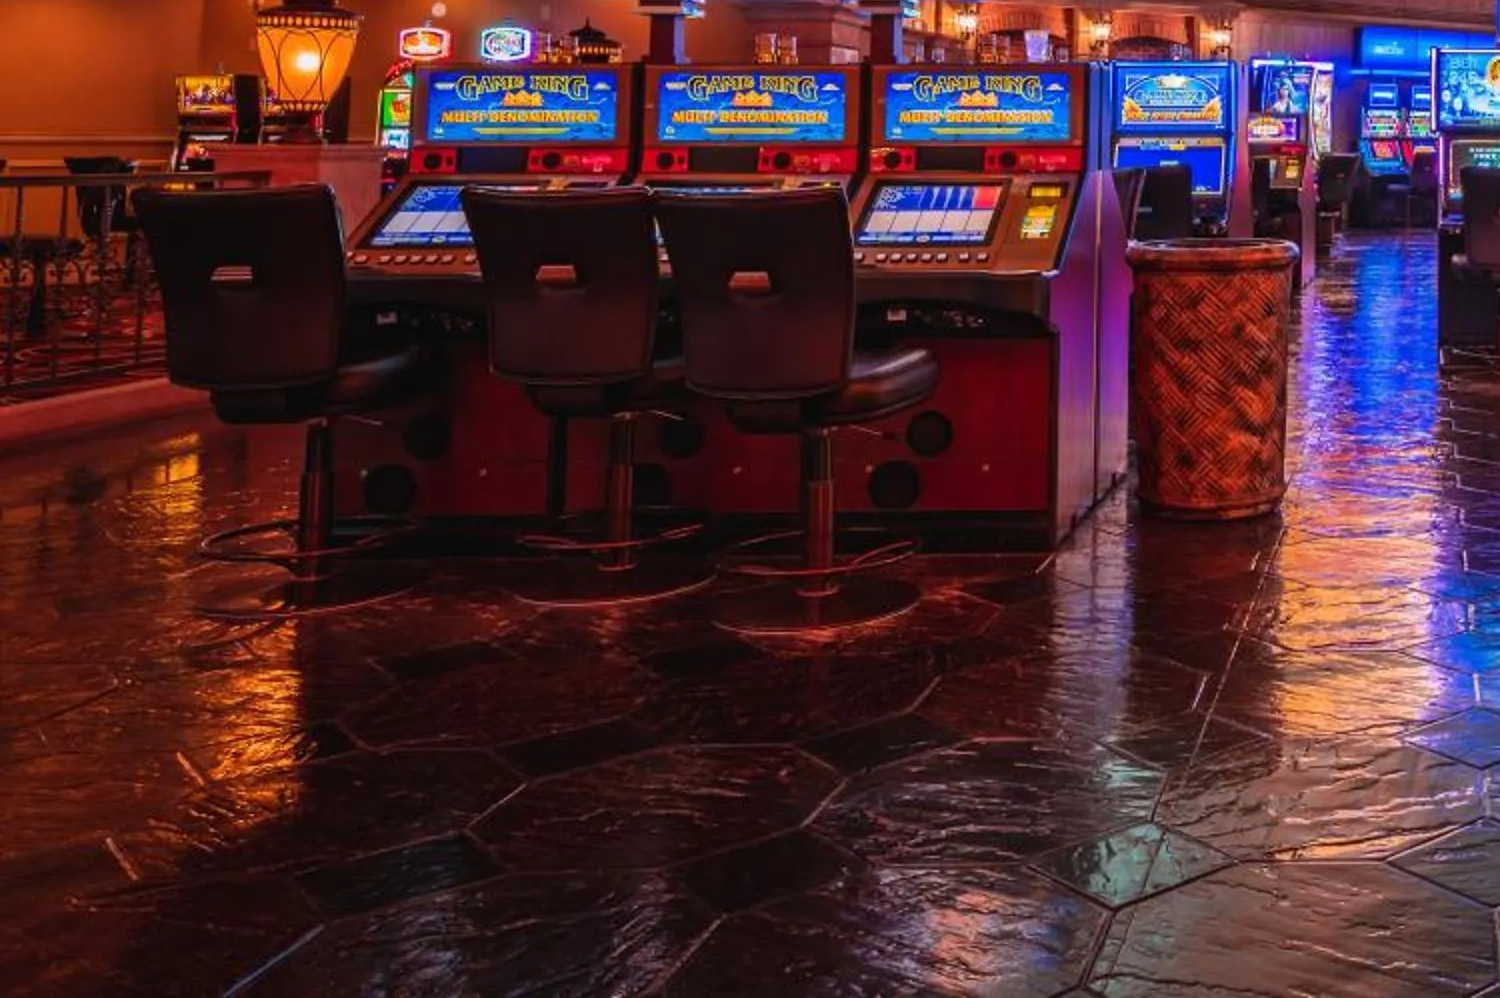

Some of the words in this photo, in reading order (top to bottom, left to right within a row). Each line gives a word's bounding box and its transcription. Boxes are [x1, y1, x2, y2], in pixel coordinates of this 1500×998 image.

[455, 75, 526, 101] GAME
[530, 75, 589, 101] KING
[687, 75, 755, 102] GAME
[759, 75, 818, 102] KING
[912, 75, 981, 102] GAME
[985, 75, 1043, 102] KING
